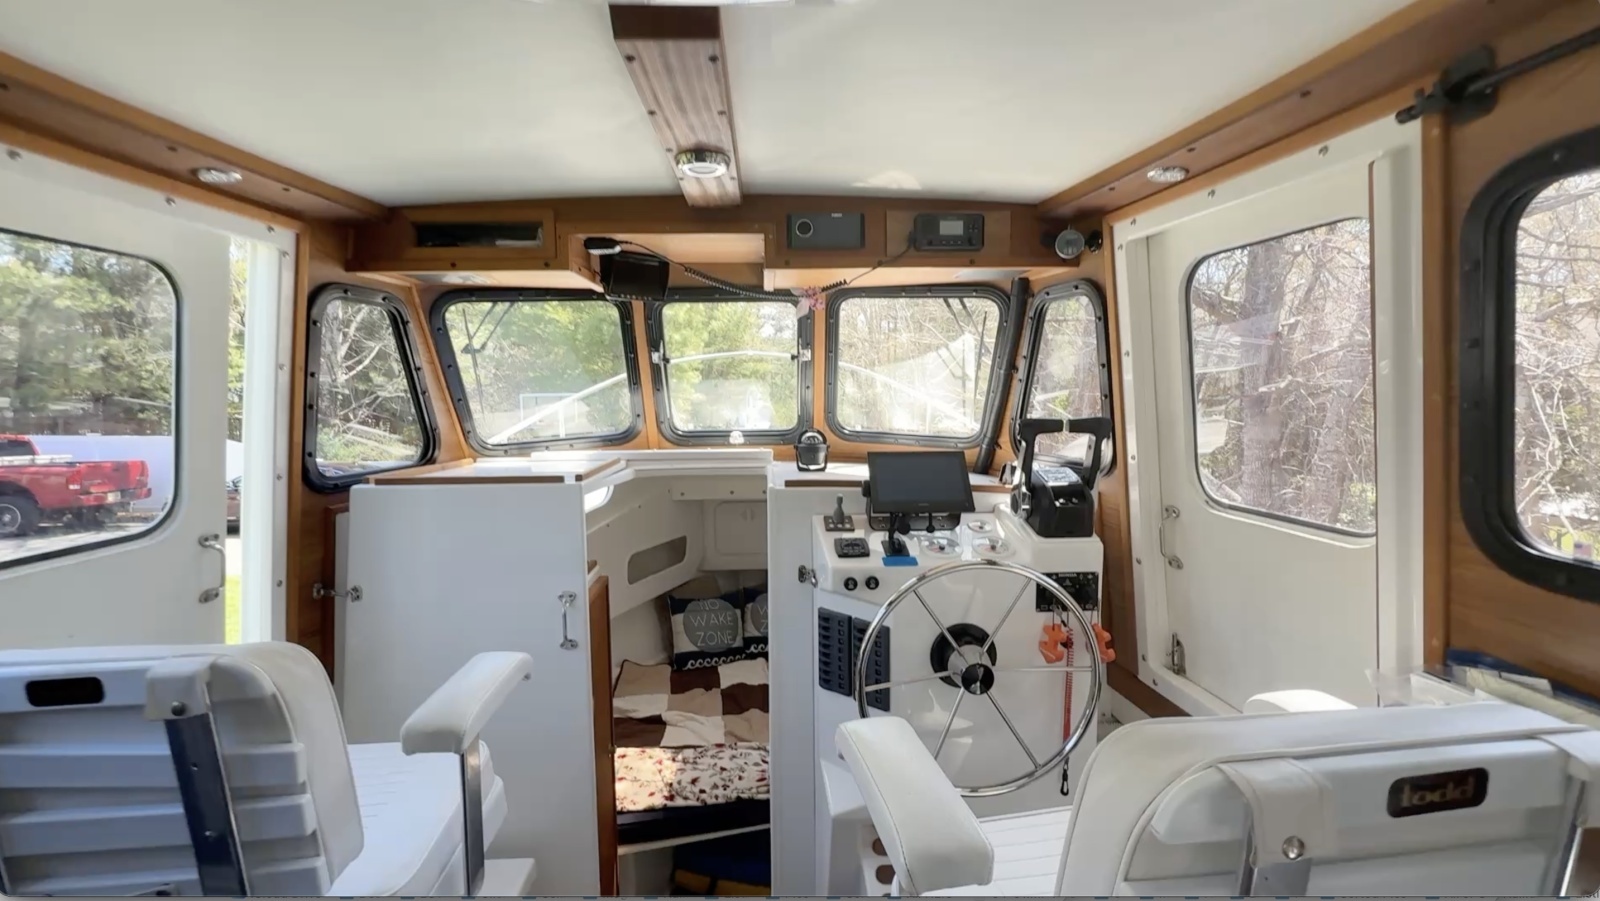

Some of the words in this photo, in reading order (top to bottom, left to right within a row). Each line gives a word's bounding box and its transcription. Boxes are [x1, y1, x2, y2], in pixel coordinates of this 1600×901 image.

[699, 600, 720, 610] NO
[690, 612, 734, 627] WAKE
[696, 631, 734, 646] ZONE
